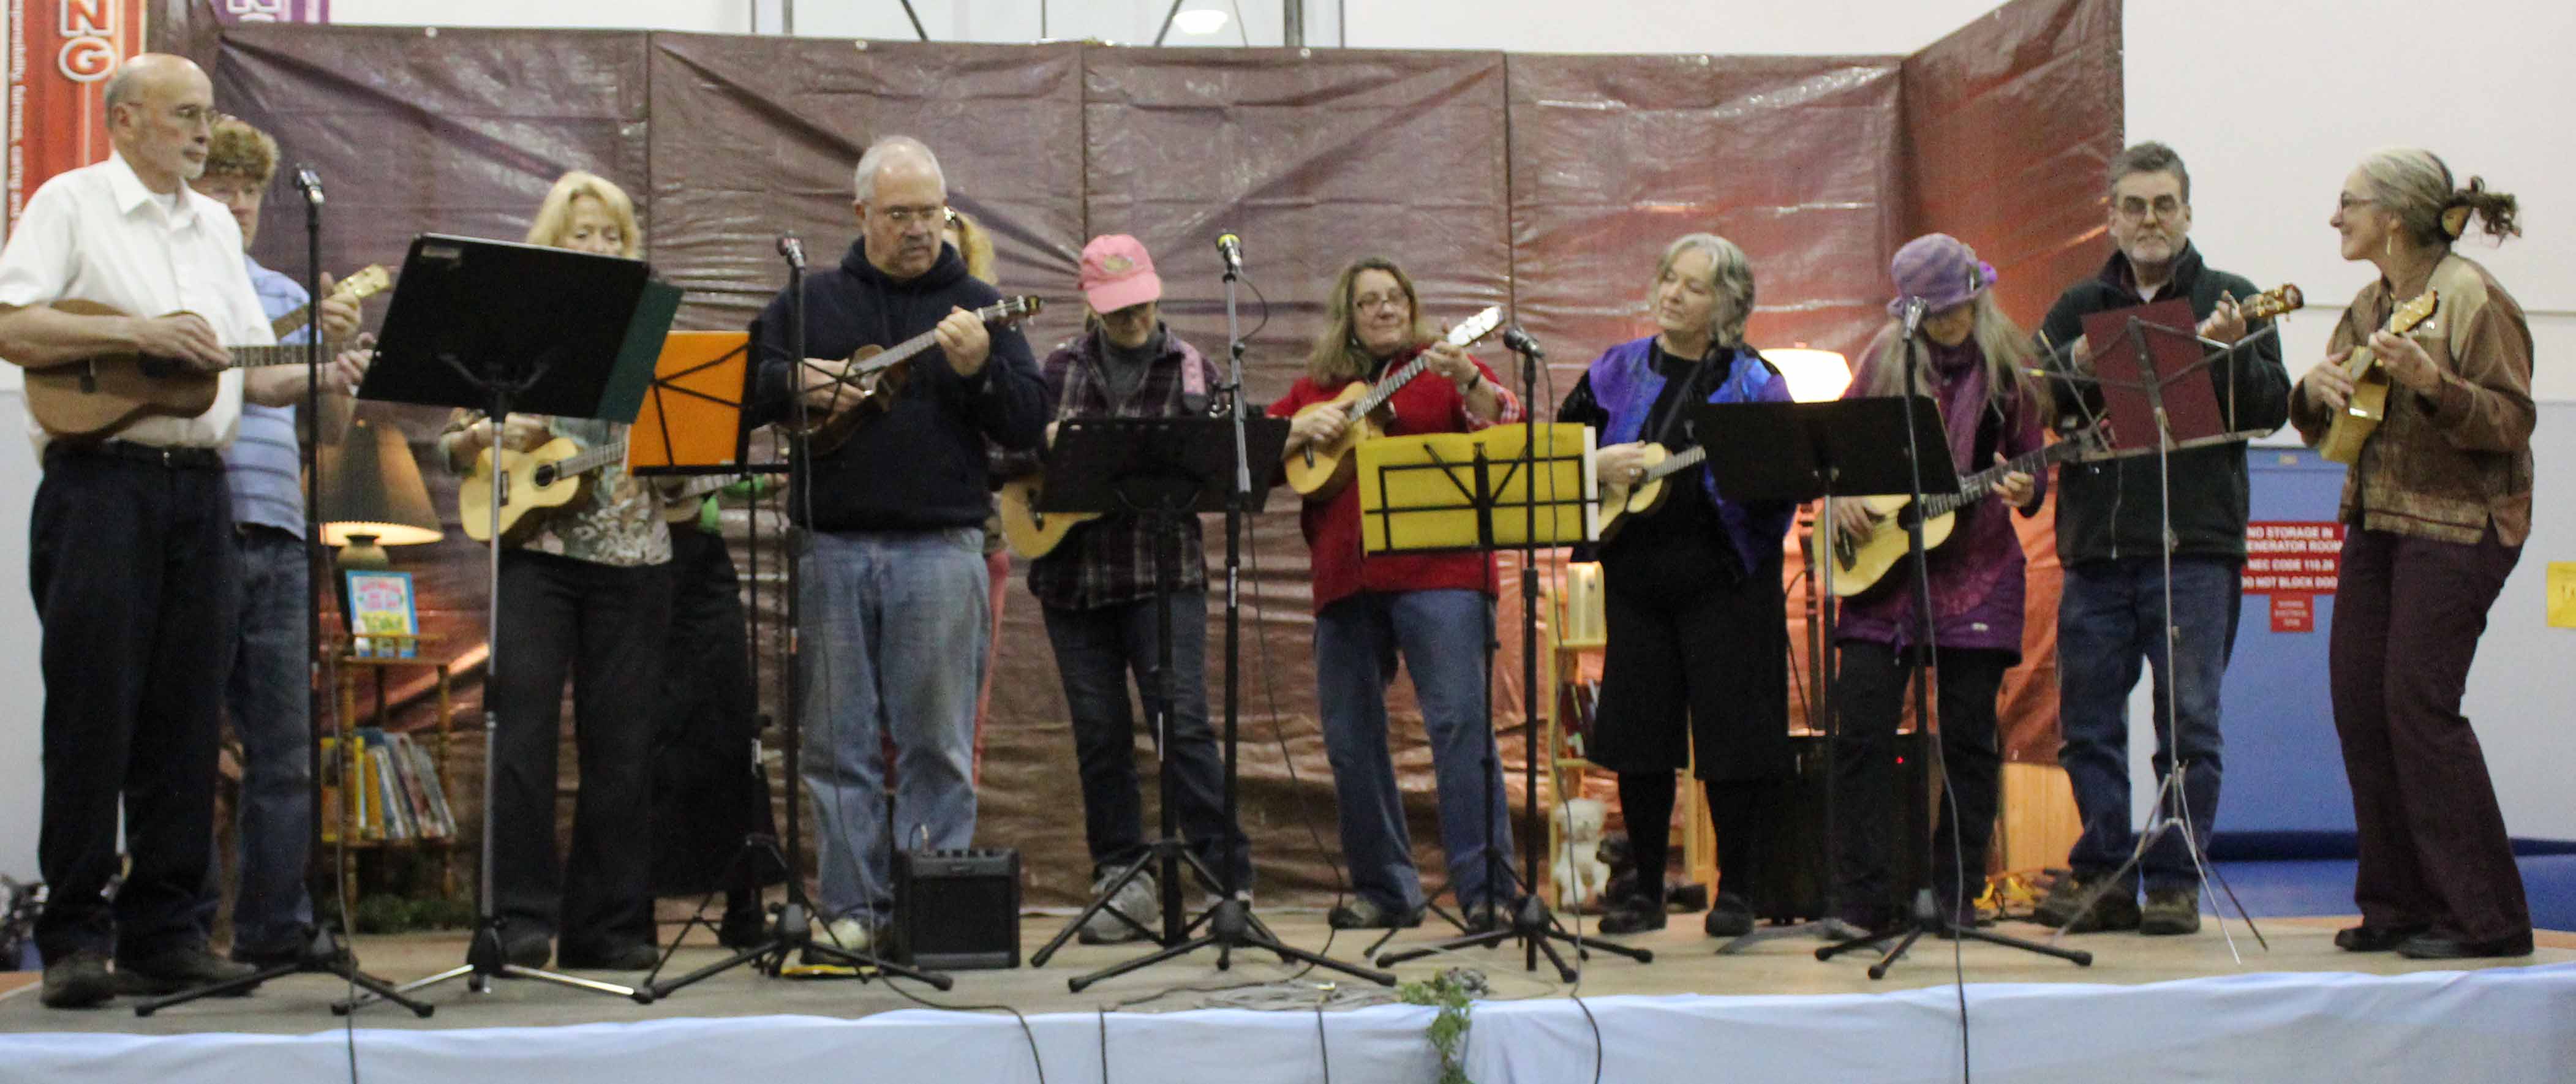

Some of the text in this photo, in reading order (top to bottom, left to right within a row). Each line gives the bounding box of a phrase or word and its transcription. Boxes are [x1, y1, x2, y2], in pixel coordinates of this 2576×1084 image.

[2246, 526, 2334, 539] NO STORAGE IN
[2245, 540, 2307, 552] ENERATOR
[2247, 559, 2270, 571] NEC
[2272, 559, 2302, 571] CODE
[2255, 576, 2276, 589] NOT
[2278, 576, 2314, 589] BLOCK
[2314, 576, 2338, 589] DOO
